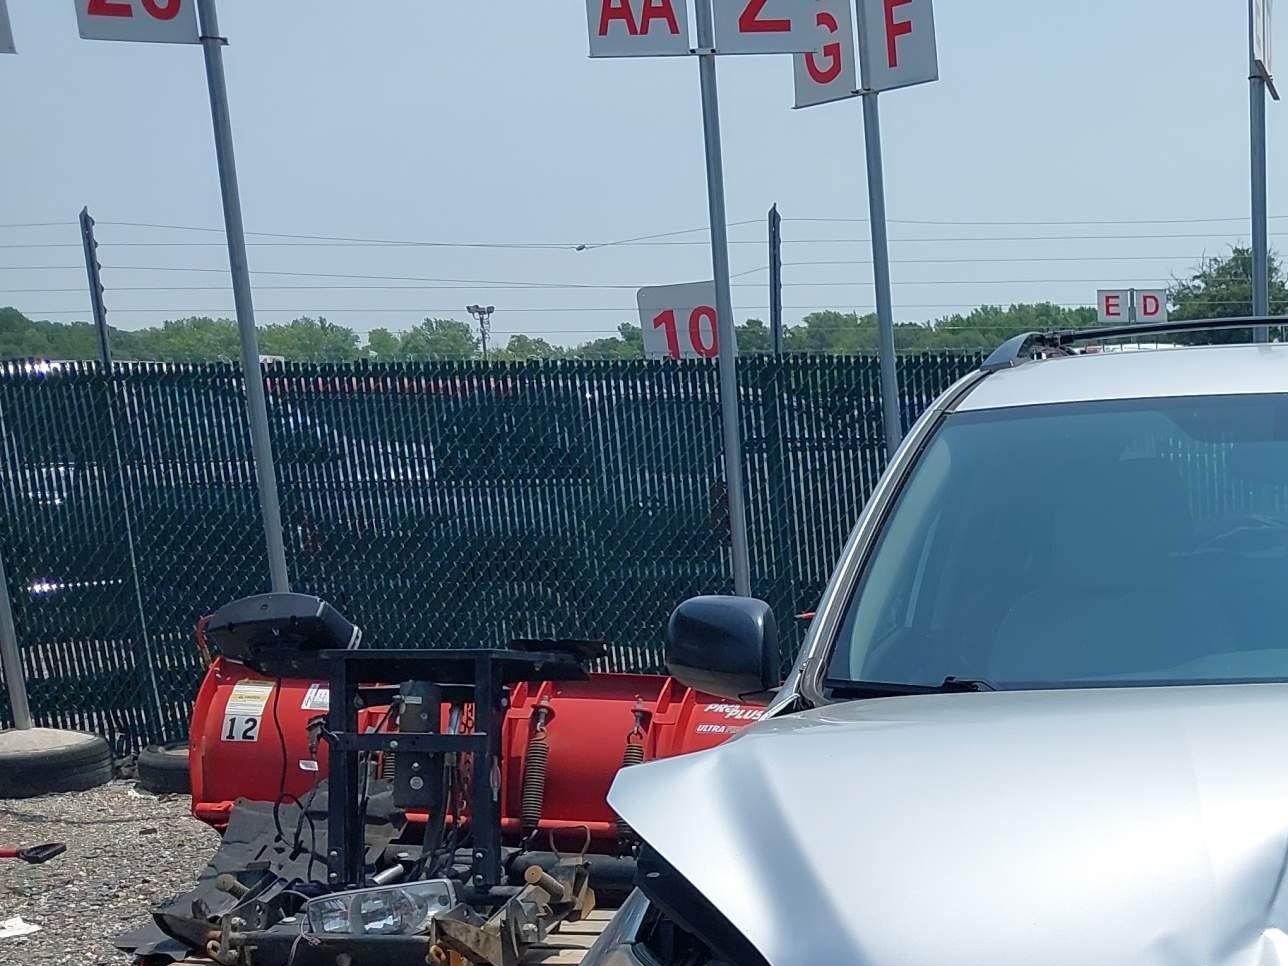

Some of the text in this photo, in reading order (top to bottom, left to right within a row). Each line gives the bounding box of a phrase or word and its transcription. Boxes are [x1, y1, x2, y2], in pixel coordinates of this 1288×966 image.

[805, 12, 842, 84] G
[884, 0, 912, 68] F
[1105, 295, 1120, 316] E
[1143, 295, 1159, 316] D
[653, 306, 719, 361] 10
[226, 717, 258, 740] 12
